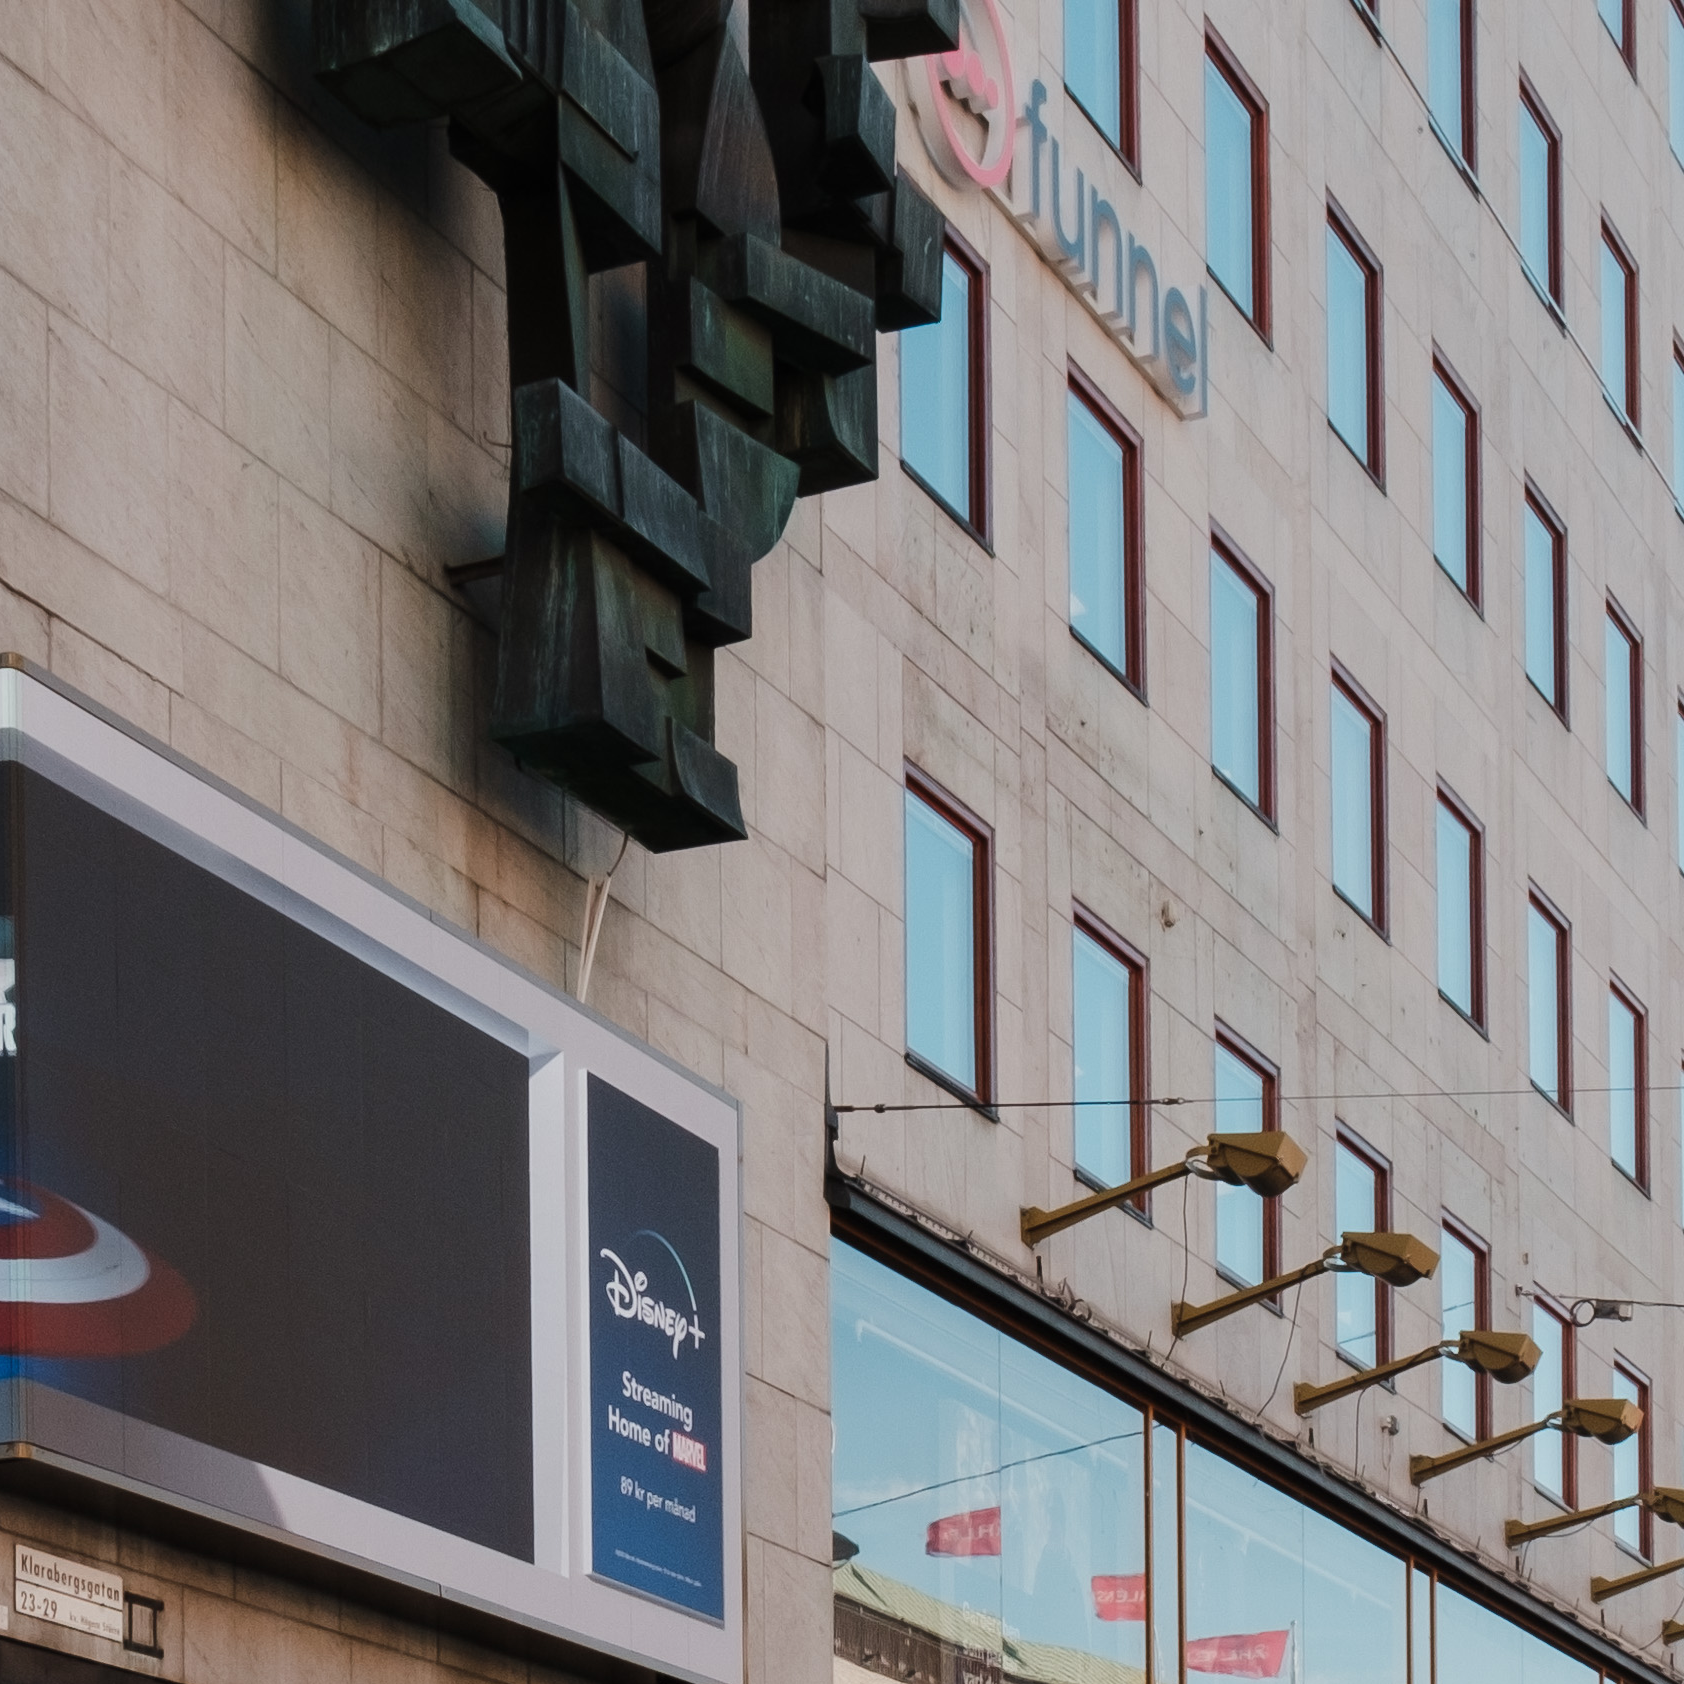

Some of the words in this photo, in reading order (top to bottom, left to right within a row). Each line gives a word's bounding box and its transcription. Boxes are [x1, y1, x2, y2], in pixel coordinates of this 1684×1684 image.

[1025, 78, 1208, 417] funnel
[622, 1371, 693, 1432] Streaming
[608, 1405, 651, 1447] Home
[655, 1430, 670, 1455] of
[673, 1432, 706, 1473] MARVEL
[620, 1476, 634, 1495] 89
[634, 1481, 645, 1501] kr
[646, 1490, 663, 1510] per
[665, 1498, 696, 1523] månad
[21, 1553, 120, 1602] Klarabergsgatan
[21, 1591, 57, 1619] 23-29
